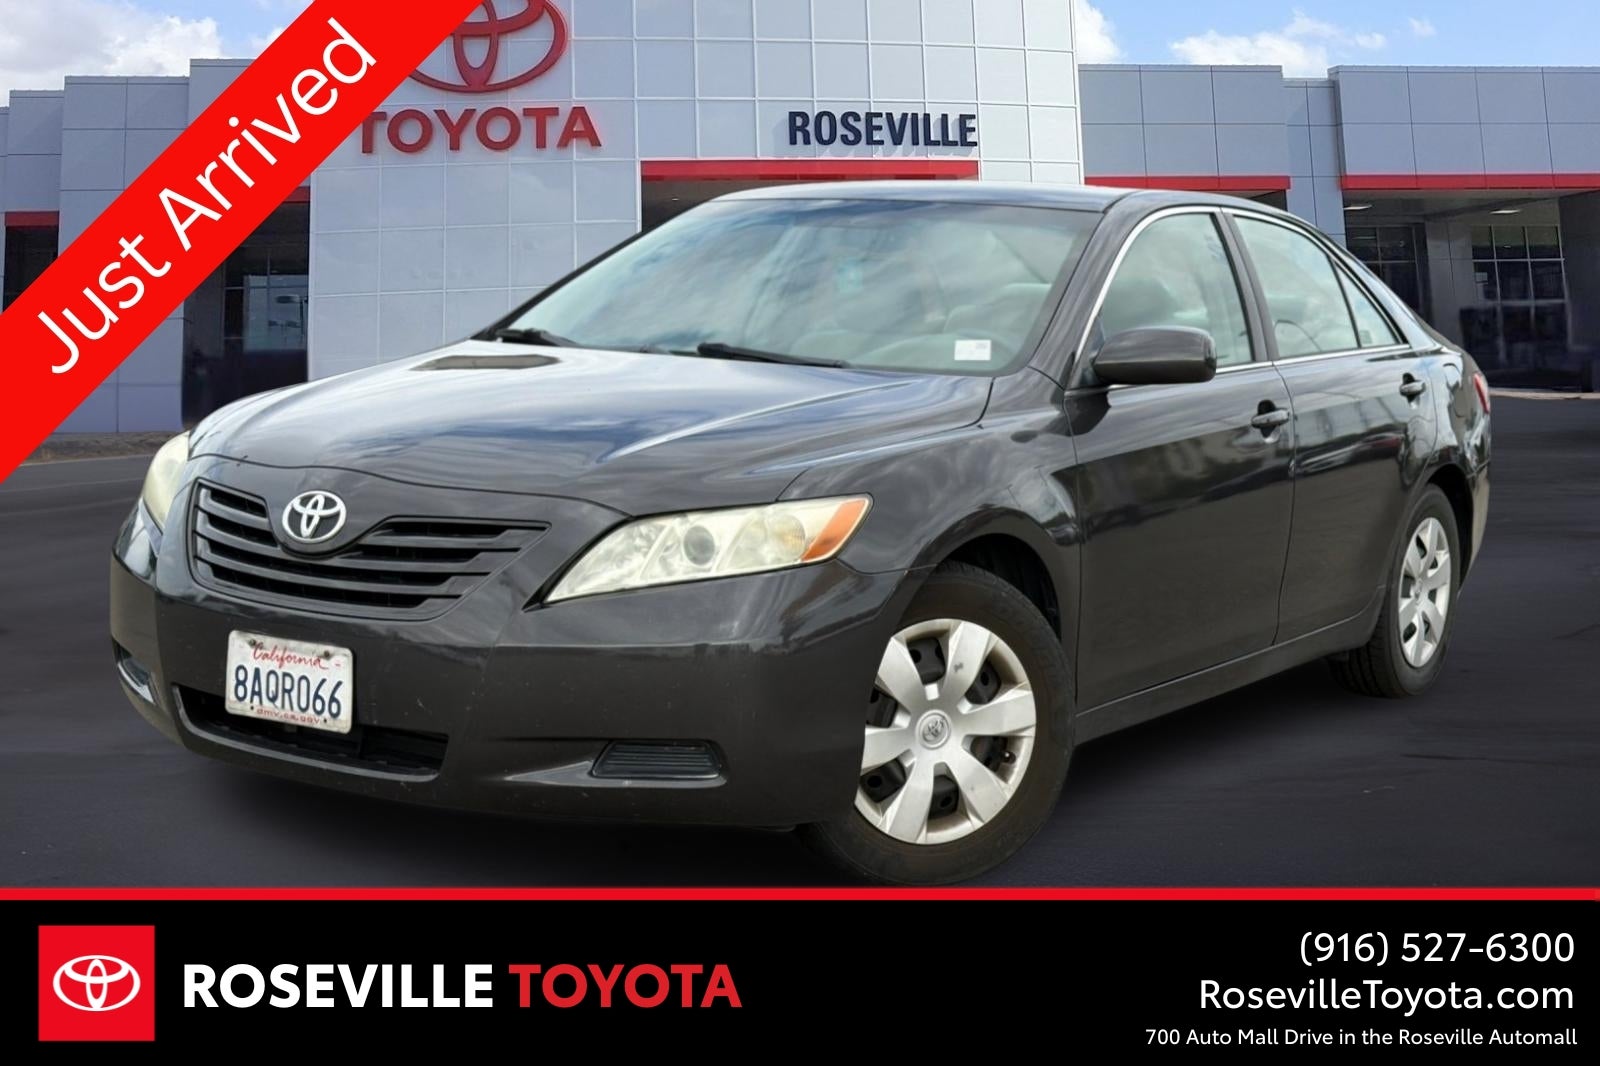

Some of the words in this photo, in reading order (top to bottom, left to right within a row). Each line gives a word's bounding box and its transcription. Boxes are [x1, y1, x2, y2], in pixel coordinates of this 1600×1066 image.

[361, 106, 602, 154] TOYOTA
[788, 110, 978, 147] ROSEVILLE
[252, 643, 329, 670] California
[234, 664, 343, 719] 8AQR066
